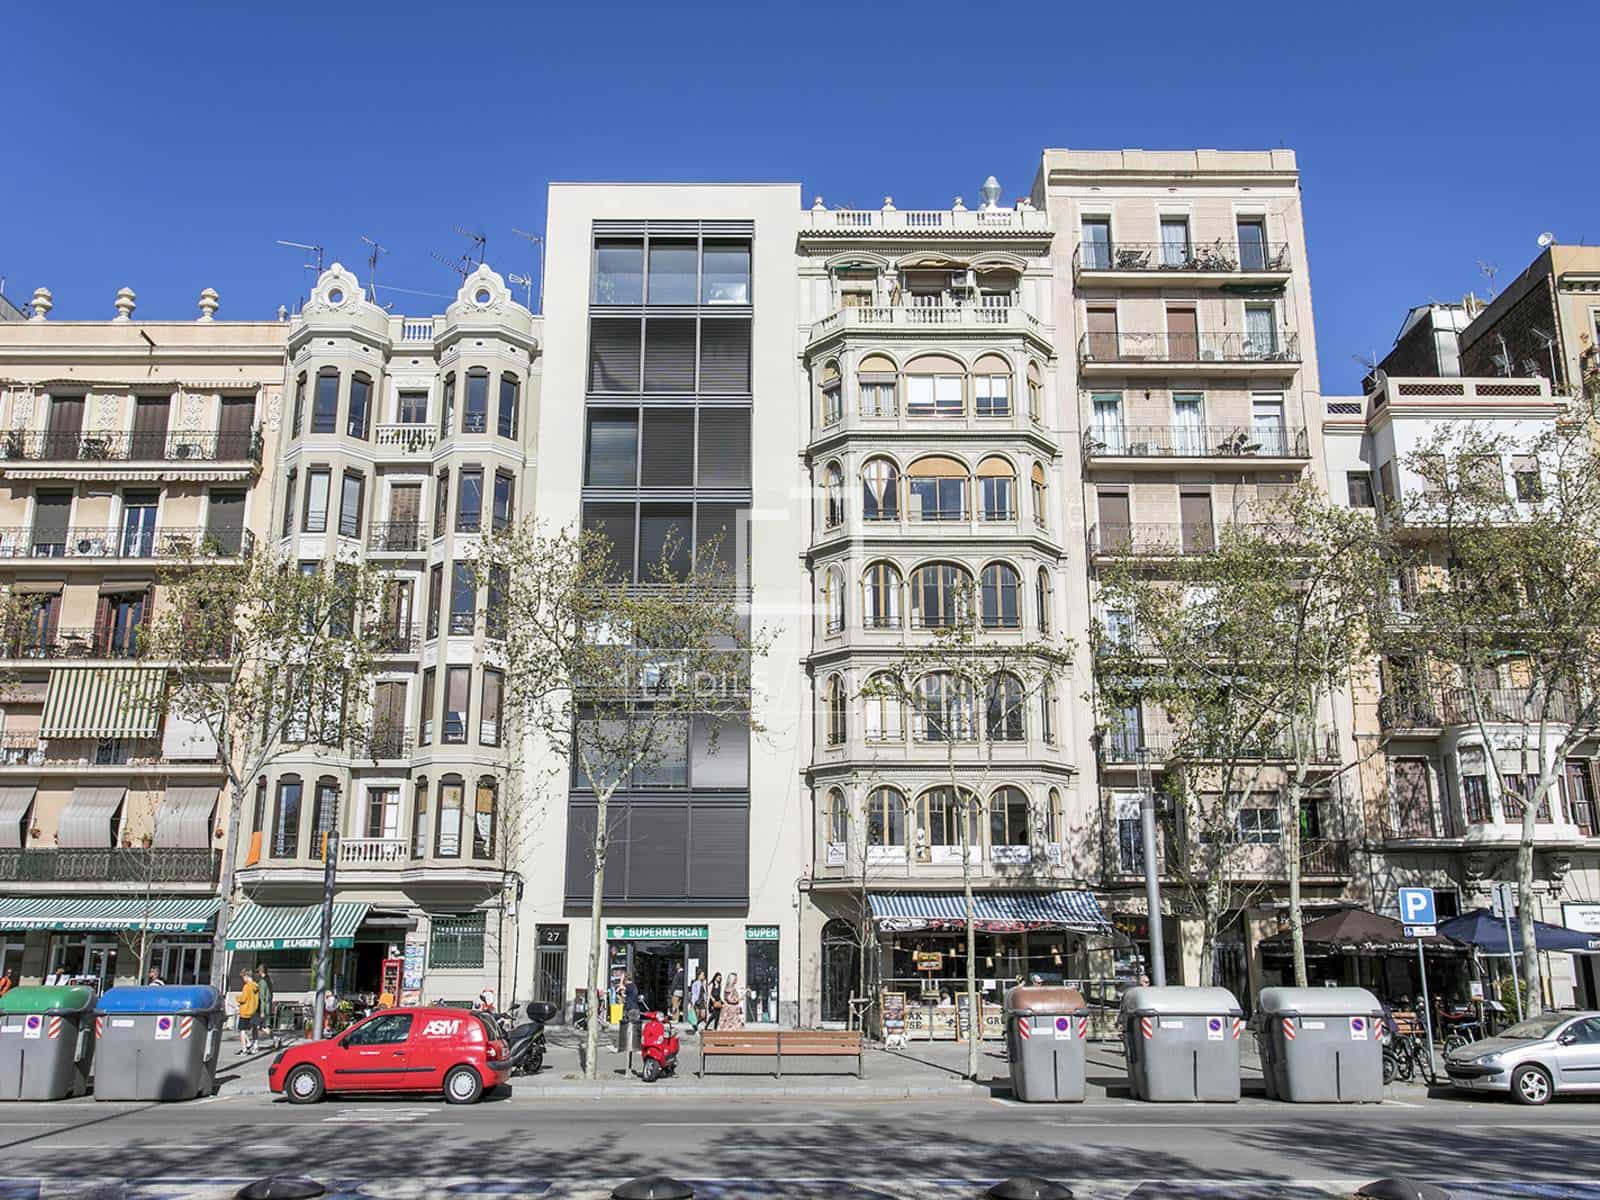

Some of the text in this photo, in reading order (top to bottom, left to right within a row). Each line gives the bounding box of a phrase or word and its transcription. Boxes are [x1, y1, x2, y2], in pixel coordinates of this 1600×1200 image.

[1406, 892, 1427, 920] P
[546, 932, 560, 942] 27
[628, 928, 703, 938] SUPERMERCAT
[748, 928, 777, 938] SUPER
[235, 940, 334, 950] GRANJA EUGENO
[423, 1020, 460, 1035] ASM
